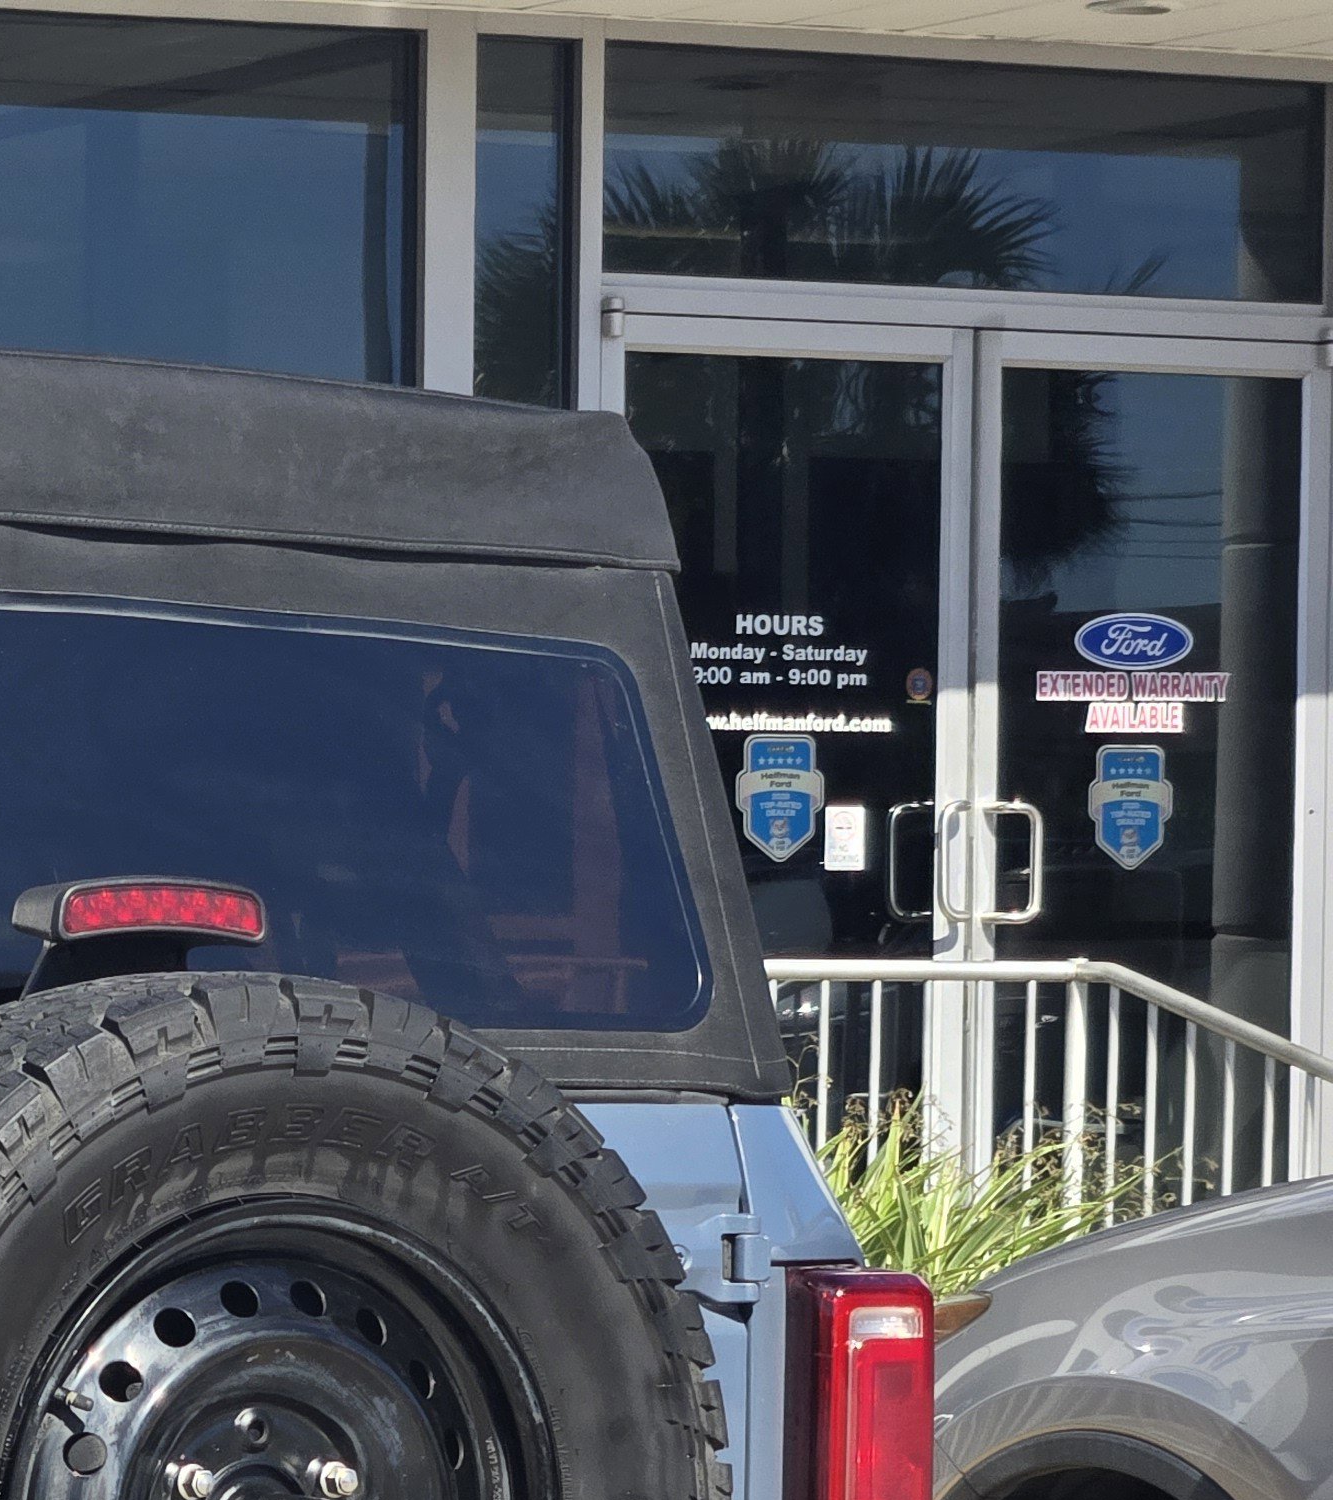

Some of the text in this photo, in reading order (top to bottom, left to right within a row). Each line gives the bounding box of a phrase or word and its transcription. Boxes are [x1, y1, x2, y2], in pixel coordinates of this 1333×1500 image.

[735, 613, 824, 637] HOURS
[1099, 623, 1169, 657] Ford
[690, 641, 766, 664] Monday
[782, 643, 867, 666] Saturday
[693, 666, 732, 685] 9:00
[739, 671, 771, 684] am
[788, 668, 831, 686] 9:00
[836, 672, 867, 689] pm
[1038, 672, 1228, 699] EXTENDED WARRANTY
[1088, 704, 1181, 730] AVAILABLE
[769, 780, 792, 788] Ford
[64, 1102, 437, 1248] GRABBER
